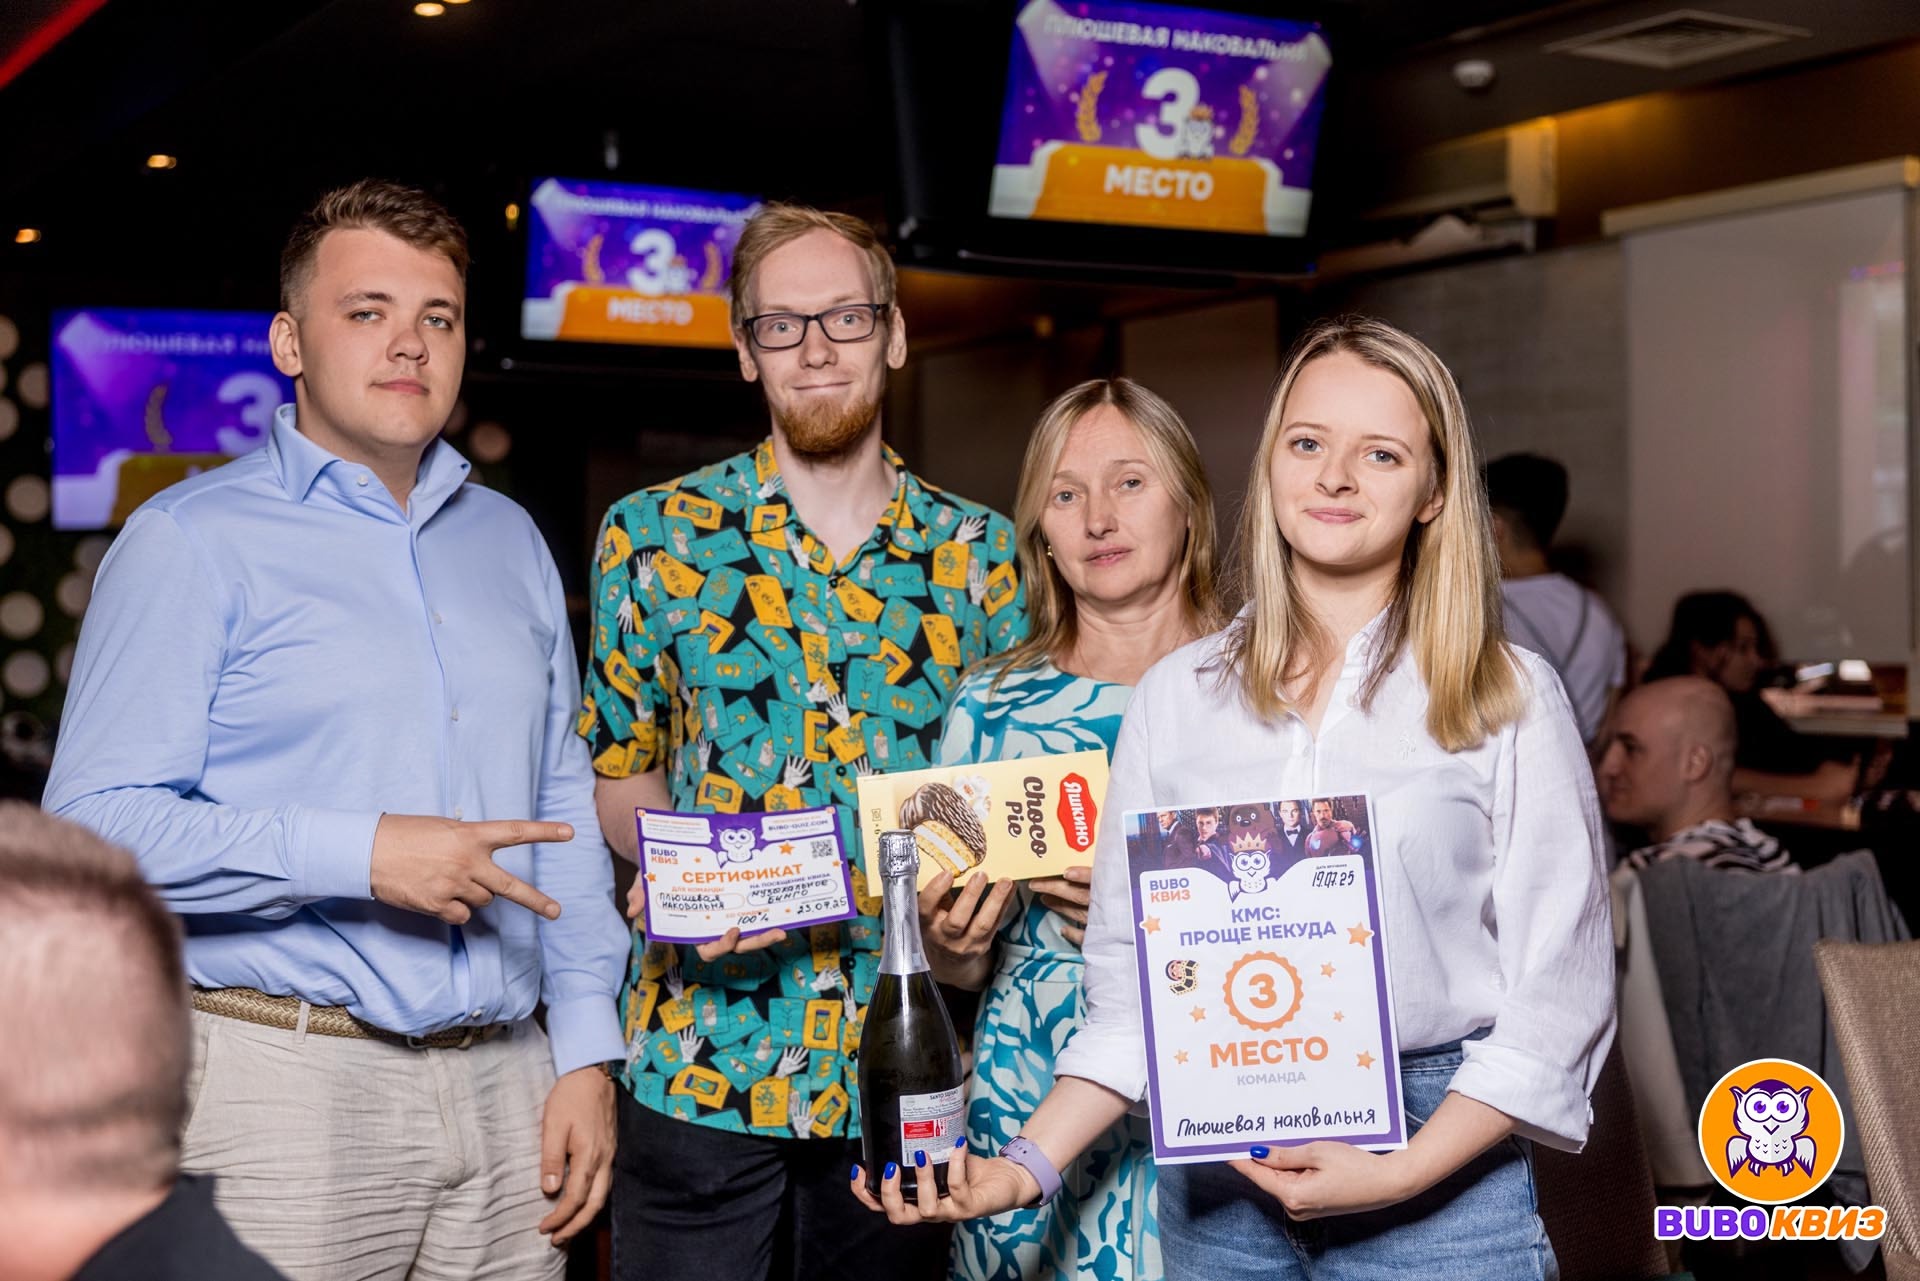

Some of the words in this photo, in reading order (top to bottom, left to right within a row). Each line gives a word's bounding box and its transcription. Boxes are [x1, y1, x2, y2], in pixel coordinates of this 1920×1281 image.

[1135, 67, 1201, 159] 3
[1104, 164, 1213, 201] МЕСТО
[626, 228, 676, 296] 3
[607, 297, 694, 325] МЕСТО
[216, 373, 281, 455] 3
[1023, 776, 1047, 858] Choco
[1063, 781, 1089, 846] ЯШКИНО
[650, 848, 678, 857] BUBO
[651, 856, 678, 865] КВИЗ
[681, 863, 803, 884] СЕРТИФИКАТ
[1150, 877, 1190, 891] BUBO
[1150, 889, 1191, 903] КВИЗ
[1231, 906, 1281, 923] КМС:
[1180, 926, 1252, 946] ПРОЩЕ
[1258, 920, 1337, 940] НЕКУДА
[1249, 973, 1278, 1009] 3
[1210, 1036, 1329, 1068] МЕСТО
[1237, 1072, 1307, 1086] КОМАНДА
[1177, 1114, 1265, 1137] Плюшевая
[1274, 1106, 1376, 1129] наковальня
